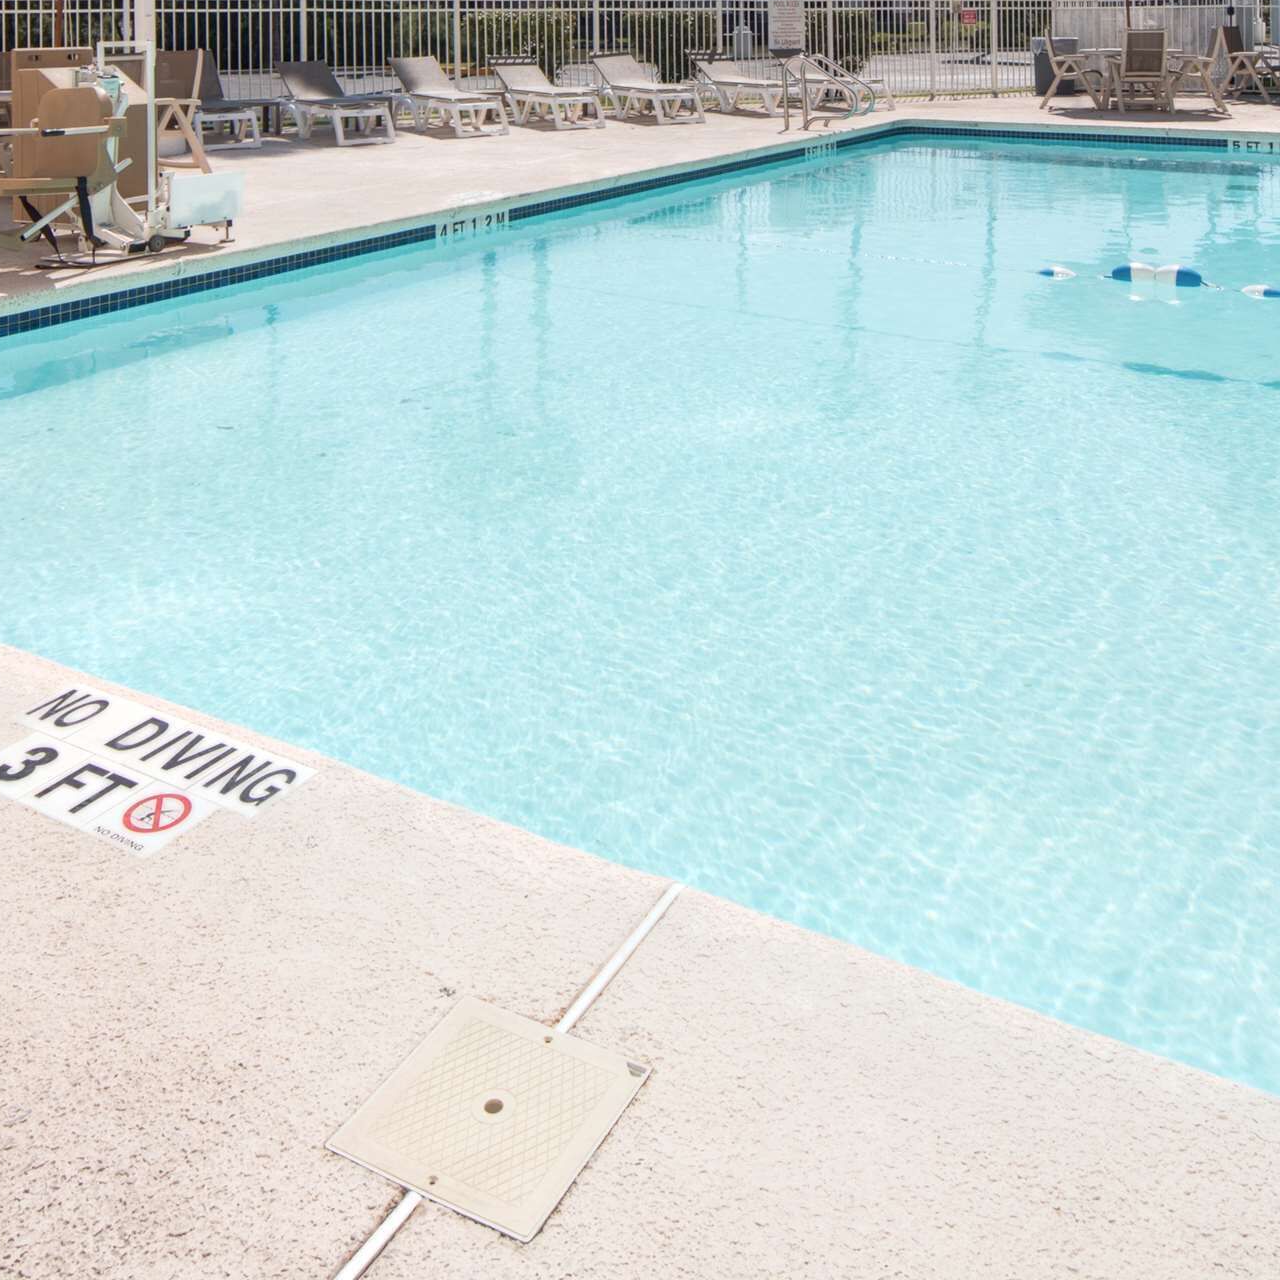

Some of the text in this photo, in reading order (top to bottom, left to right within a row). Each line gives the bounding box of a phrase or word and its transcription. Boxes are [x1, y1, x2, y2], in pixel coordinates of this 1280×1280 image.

[453, 220, 465, 234] FT
[25, 688, 297, 806] NO DIVING
[34, 763, 139, 814] FT
[95, 826, 144, 851] NO DIVING
